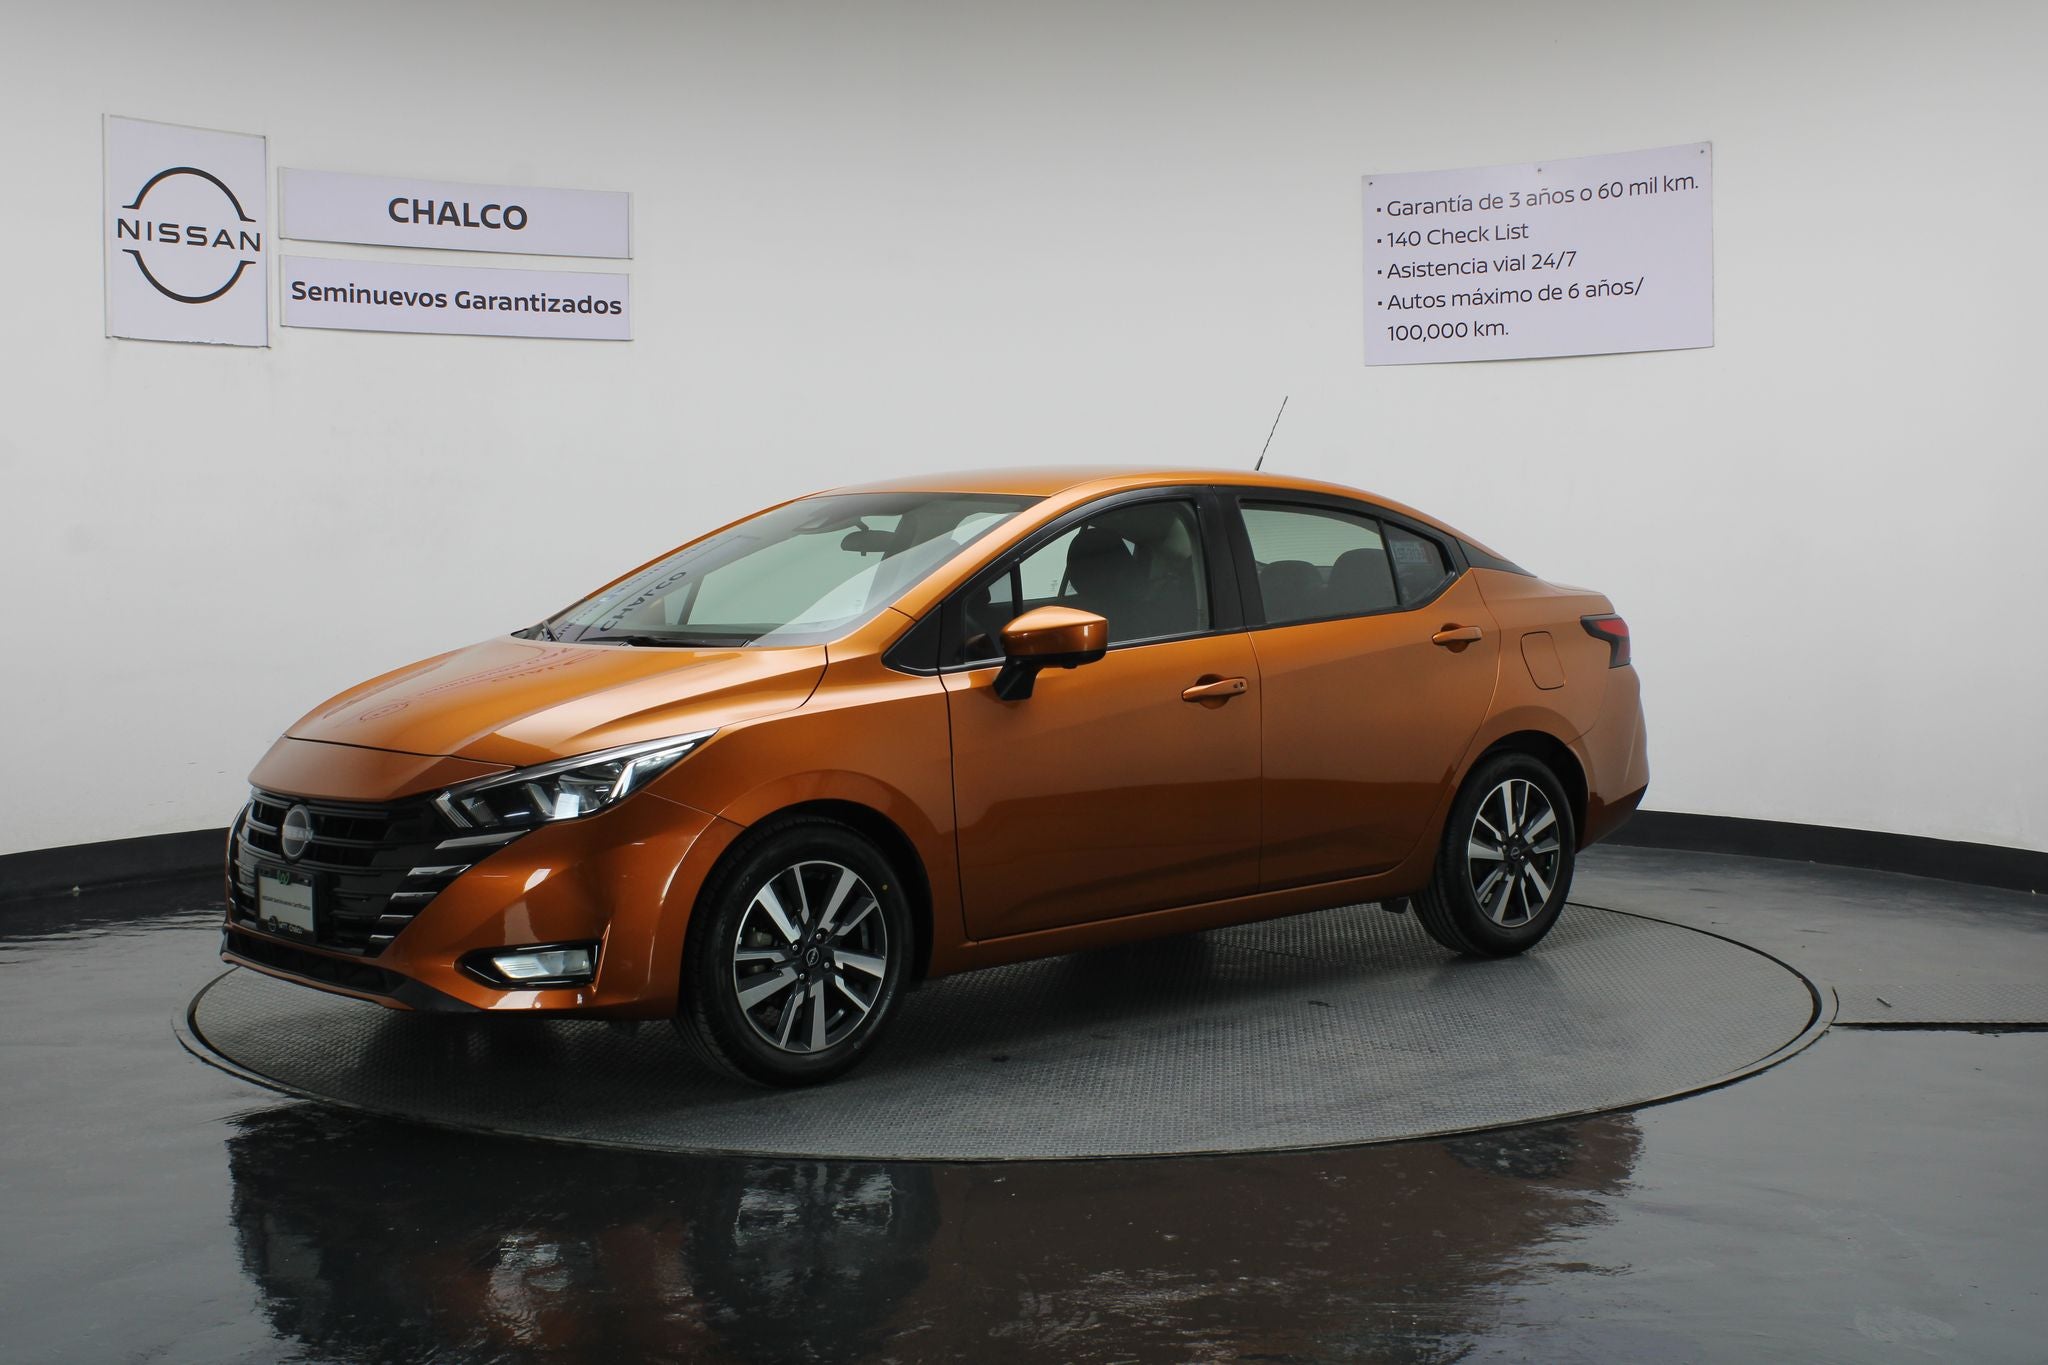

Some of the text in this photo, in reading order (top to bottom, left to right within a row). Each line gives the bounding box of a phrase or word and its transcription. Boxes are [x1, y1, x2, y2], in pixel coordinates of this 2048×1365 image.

[1386, 175, 1699, 217] Garantía de 3 años o 60 mil km.
[388, 197, 528, 231] CHALCO
[117, 218, 261, 252] NISSAN
[1386, 223, 1529, 248] 140 Check List
[1386, 250, 1577, 280] Asistencia vial 24/7
[291, 280, 622, 315] Seminuevos Garantizados
[1387, 276, 1645, 311] Autos máximo de 6 años/
[1387, 320, 1509, 343] 100,000 km.
